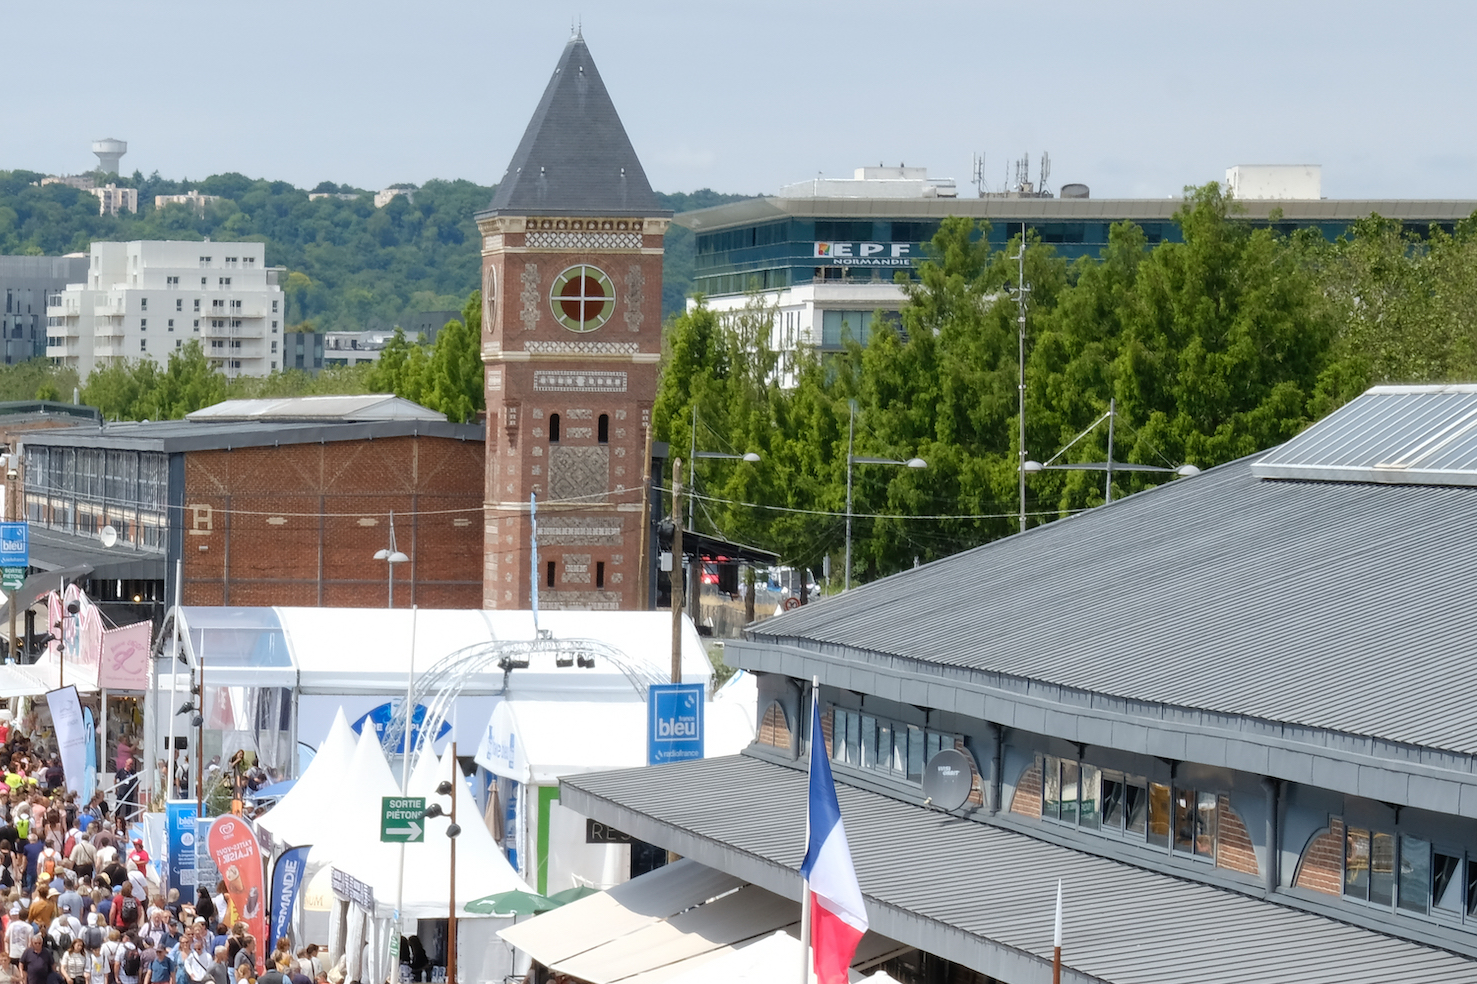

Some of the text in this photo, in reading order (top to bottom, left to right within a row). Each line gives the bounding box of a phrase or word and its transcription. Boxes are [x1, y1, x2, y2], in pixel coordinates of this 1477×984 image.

[834, 243, 911, 258] EPF
[833, 258, 910, 266] NORMANDIE
[3, 540, 23, 551] bleu
[659, 718, 695, 736] bleu
[663, 749, 700, 758] radiofrance
[389, 800, 422, 809] SORTIE
[276, 859, 297, 938] ORMANDIE
